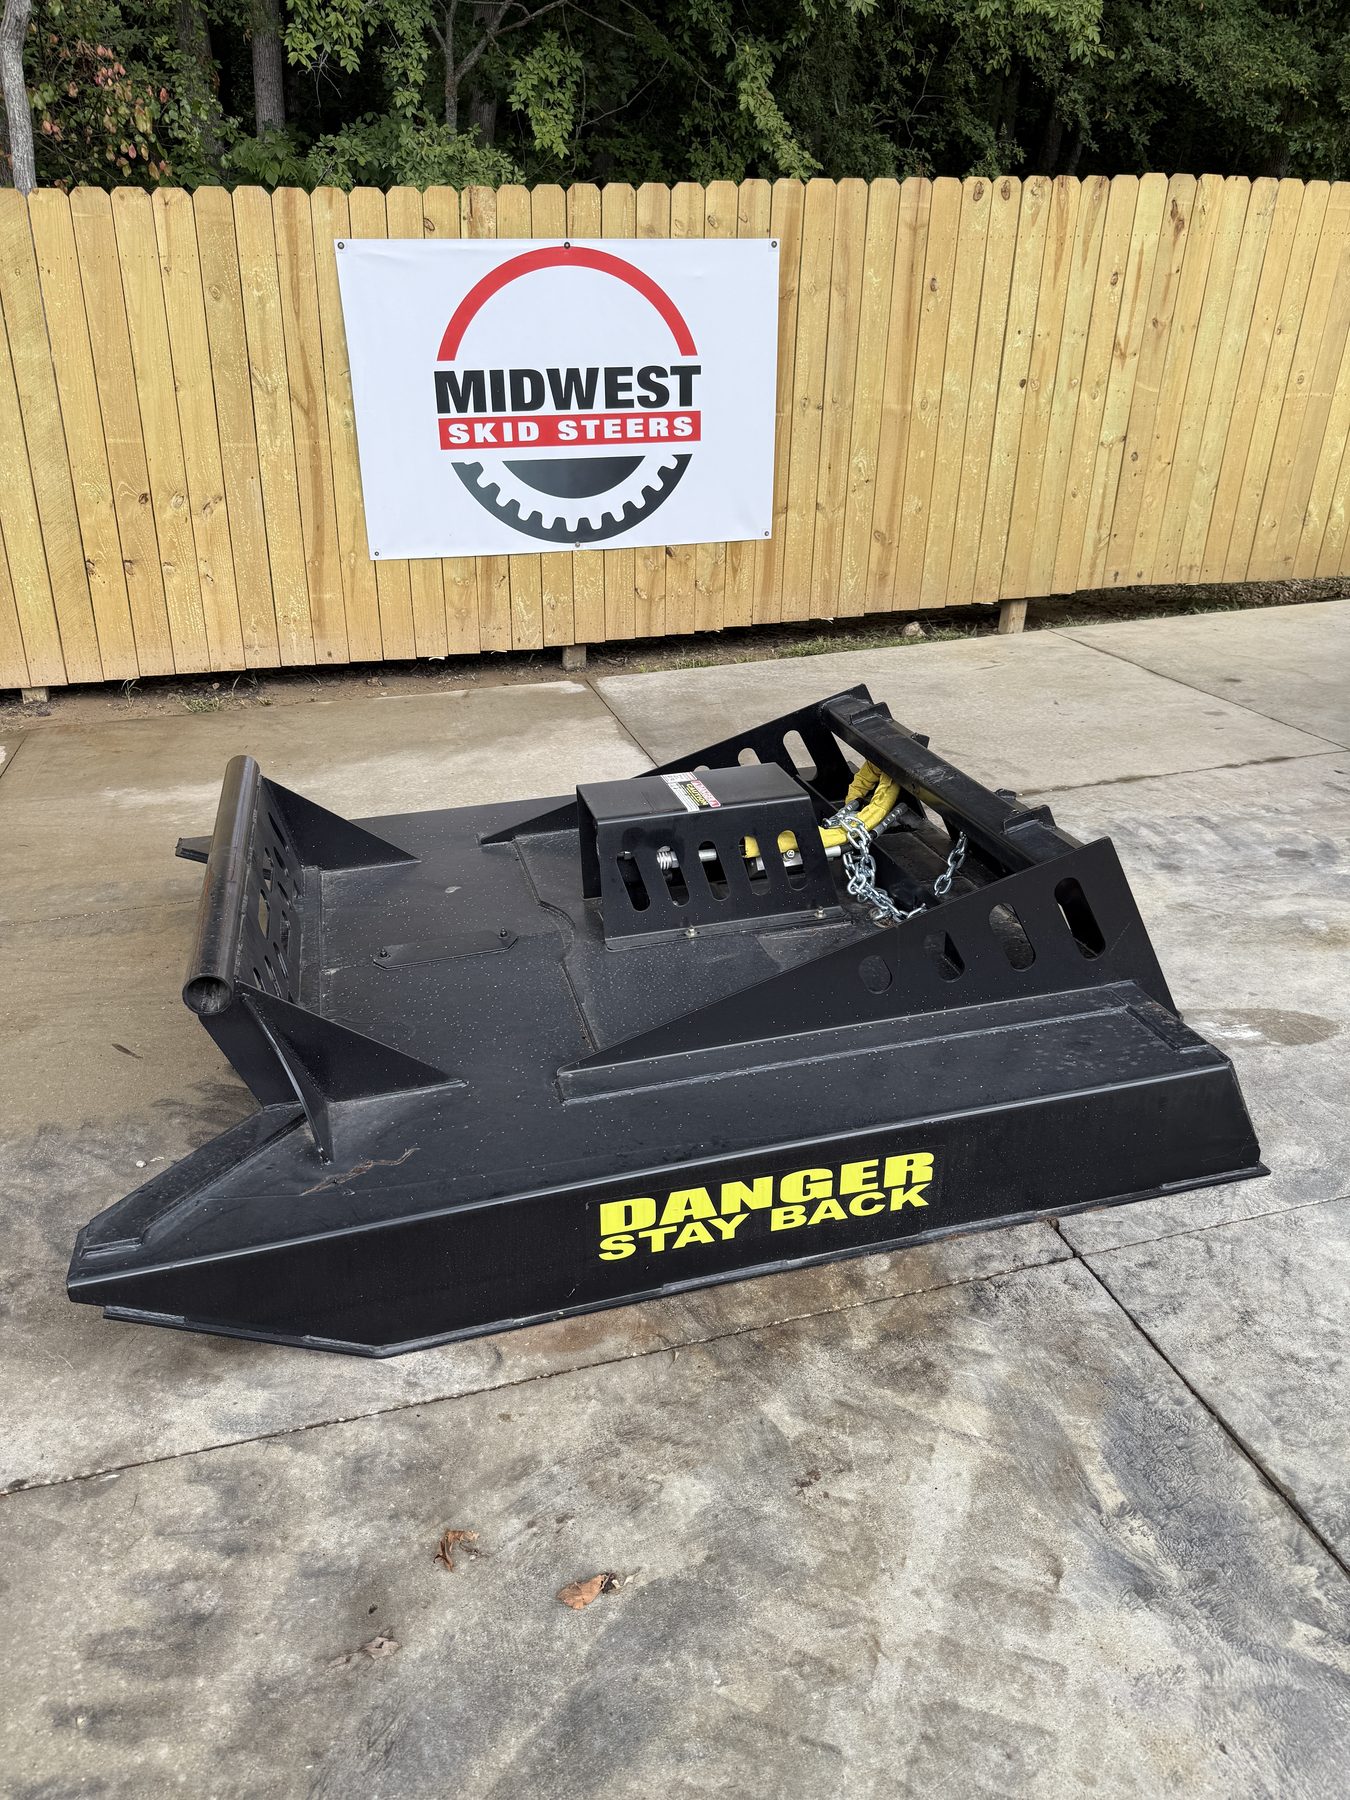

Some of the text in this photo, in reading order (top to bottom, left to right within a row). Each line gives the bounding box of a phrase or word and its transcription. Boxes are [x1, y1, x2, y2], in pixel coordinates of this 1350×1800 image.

[434, 365, 702, 414] MIDWEST
[448, 416, 693, 444] SKID STEERS
[598, 1183, 930, 1261] STAY BACK
[600, 1152, 935, 1236] DANGER
